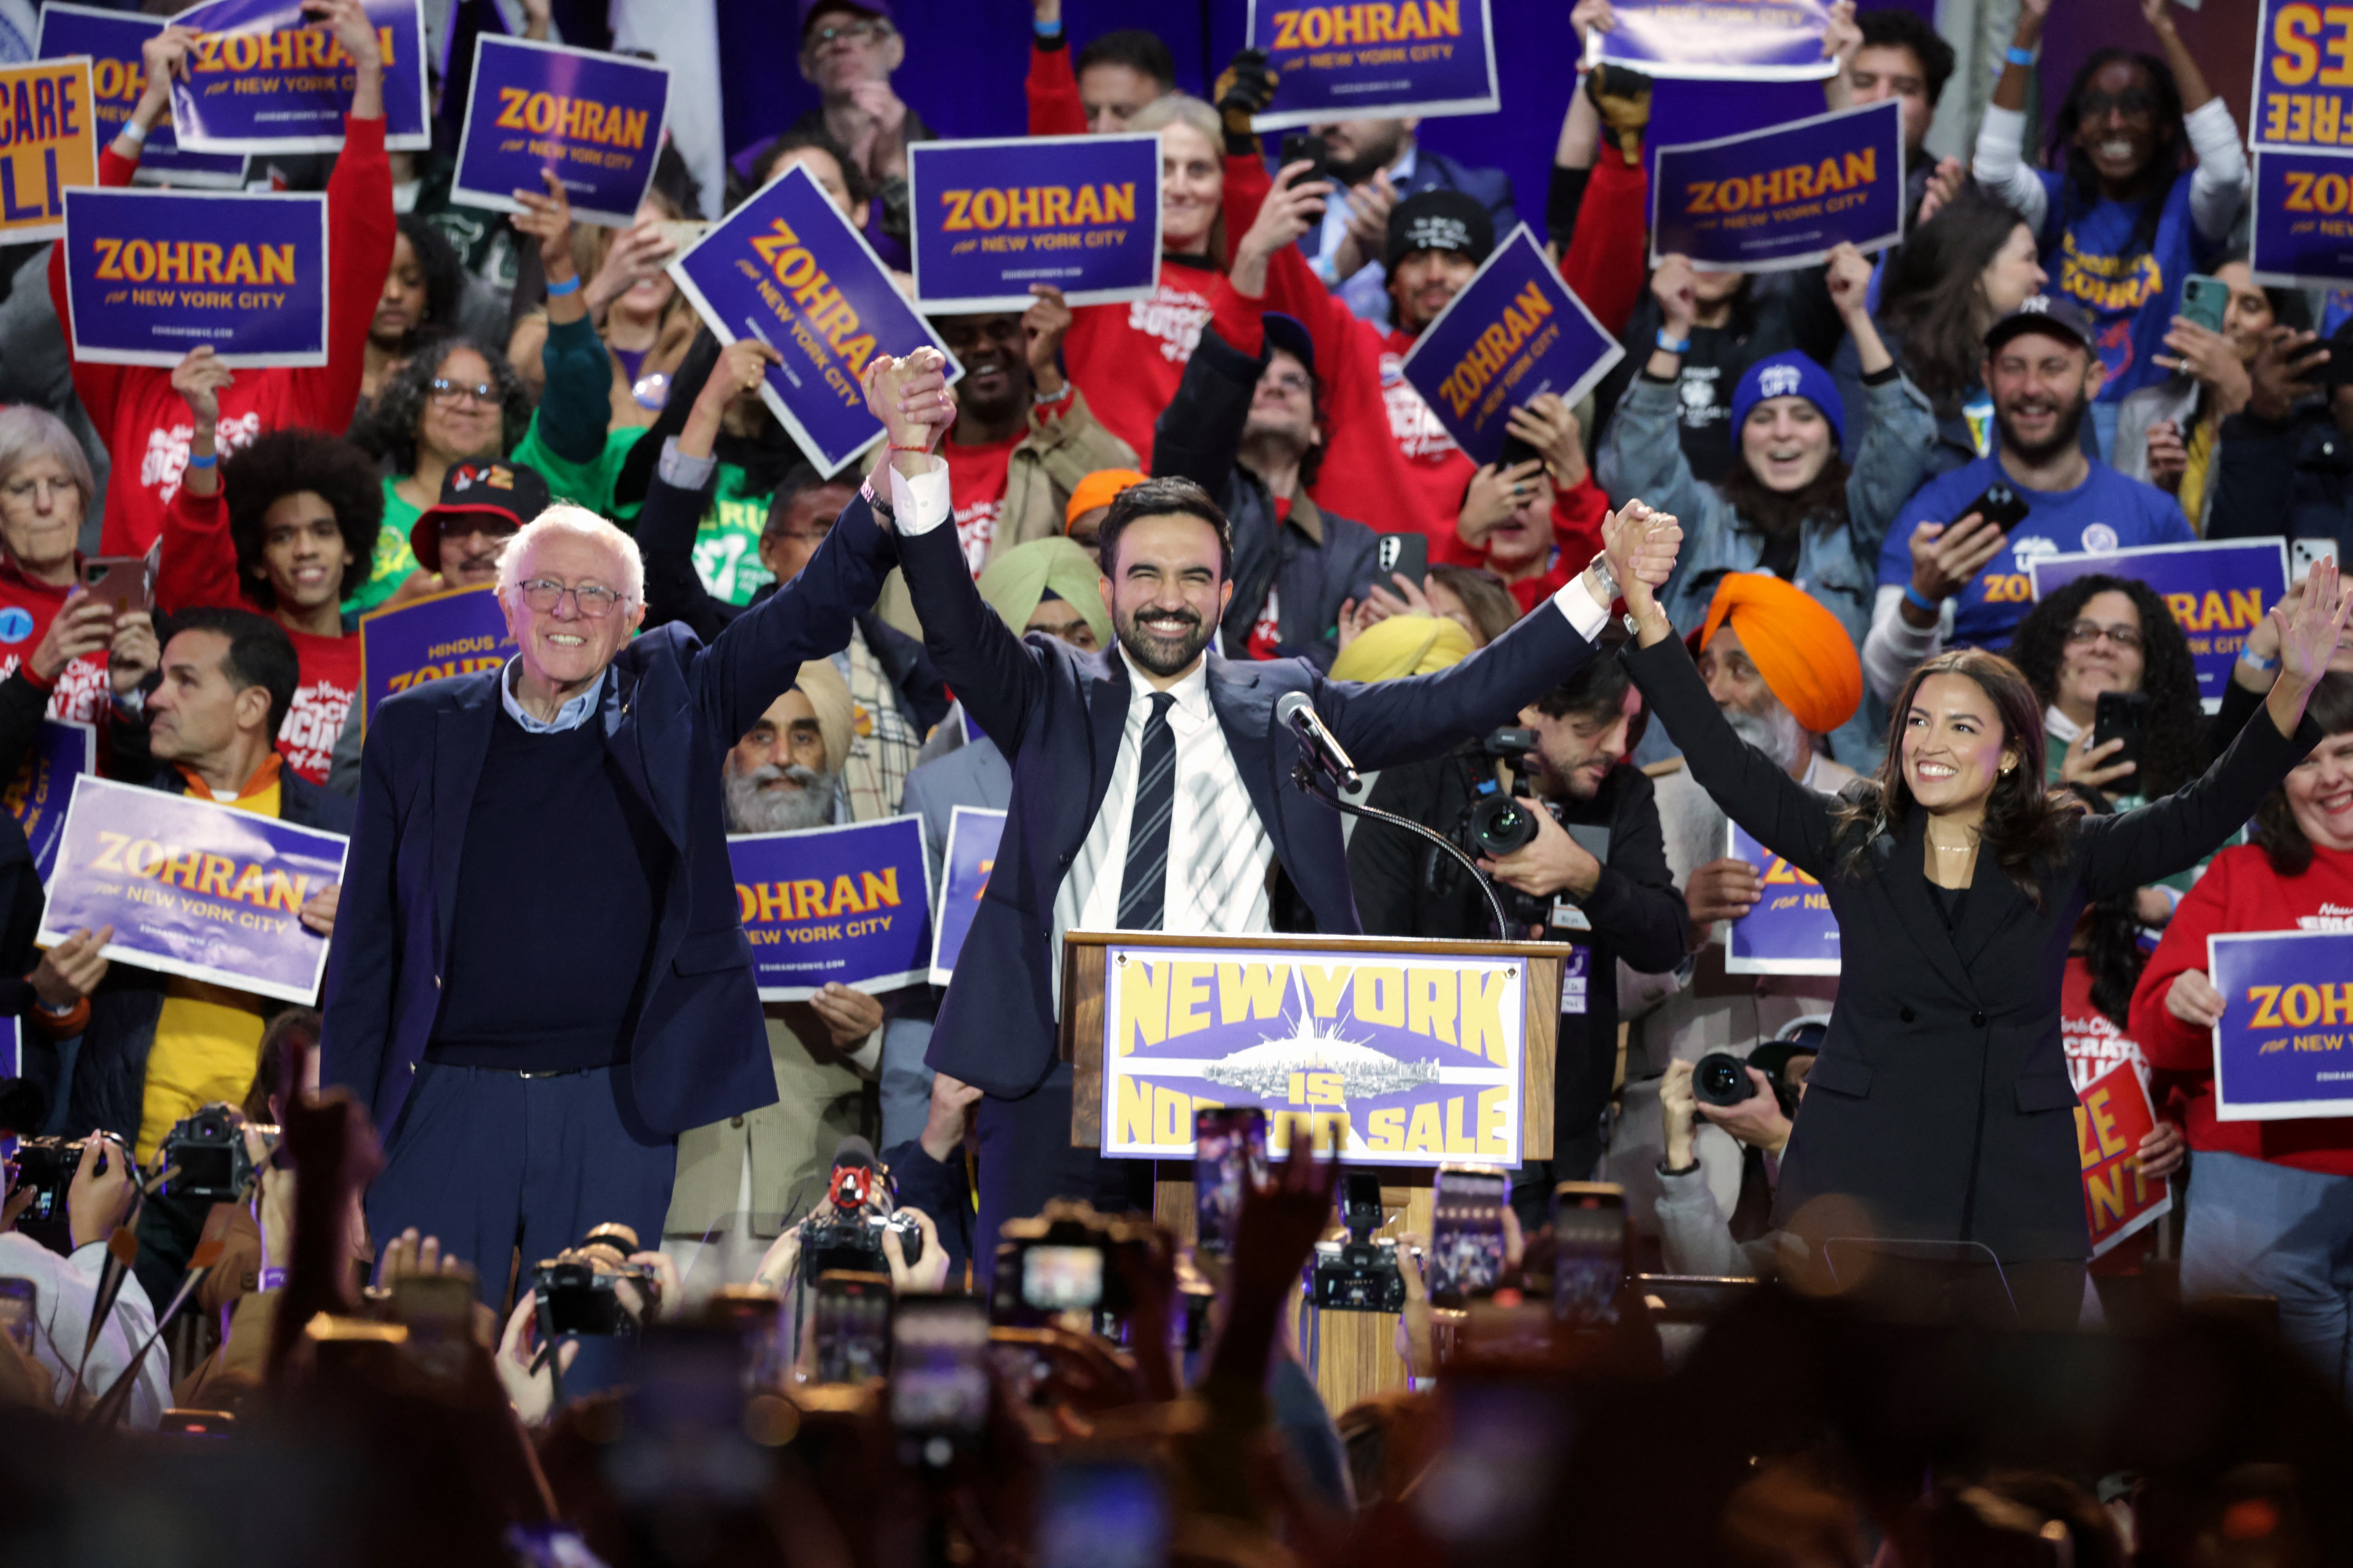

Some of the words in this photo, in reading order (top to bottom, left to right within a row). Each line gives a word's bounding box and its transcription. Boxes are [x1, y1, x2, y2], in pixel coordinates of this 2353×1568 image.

[1272, 0, 1463, 50] ZOHRAN
[1309, 50, 1353, 70] NEW
[1357, 45, 1407, 65] YORK
[1410, 43, 1455, 62] CITY
[234, 77, 280, 95] NEW
[285, 76, 337, 93] YORK
[496, 86, 649, 149] ZOHRAN
[528, 140, 565, 159] NEW
[1684, 147, 1878, 214] ZOHRAN
[942, 182, 1136, 231] ZOHRAN
[1722, 210, 1769, 230] NEW
[1773, 201, 1823, 223] YORK
[1826, 191, 1868, 214] CITY
[93, 238, 296, 284] ZOHRAN
[981, 234, 1028, 253] NEW
[1031, 231, 1082, 251] YORK
[1085, 229, 1127, 249] CITY
[132, 289, 175, 306] NEW
[179, 291, 234, 309] YORK
[238, 292, 285, 309] CITY
[749, 217, 888, 385] ZOHRA
[756, 277, 794, 323] NEW
[790, 324, 829, 371] YORK
[825, 368, 861, 407] CITY
[1438, 280, 1554, 420] ZOHRAN
[2162, 588, 2262, 632] RAN
[429, 636, 495, 660] HINDUS
[2215, 636, 2246, 654] CIT
[90, 830, 309, 914] ZOHRAN
[126, 885, 176, 913] NEW
[180, 898, 235, 924] YORK
[238, 912, 288, 935] CITY
[1804, 892, 1830, 909] NE
[786, 923, 842, 944] YORK
[846, 915, 893, 939] CITY
[1118, 960, 1291, 1057] NEW
[1298, 964, 1509, 1069] YORK
[2061, 1015, 2089, 1034] ork
[2293, 1035, 2343, 1052] NEW
[1289, 1071, 1343, 1105] IS
[1368, 1084, 1508, 1155] SALE
